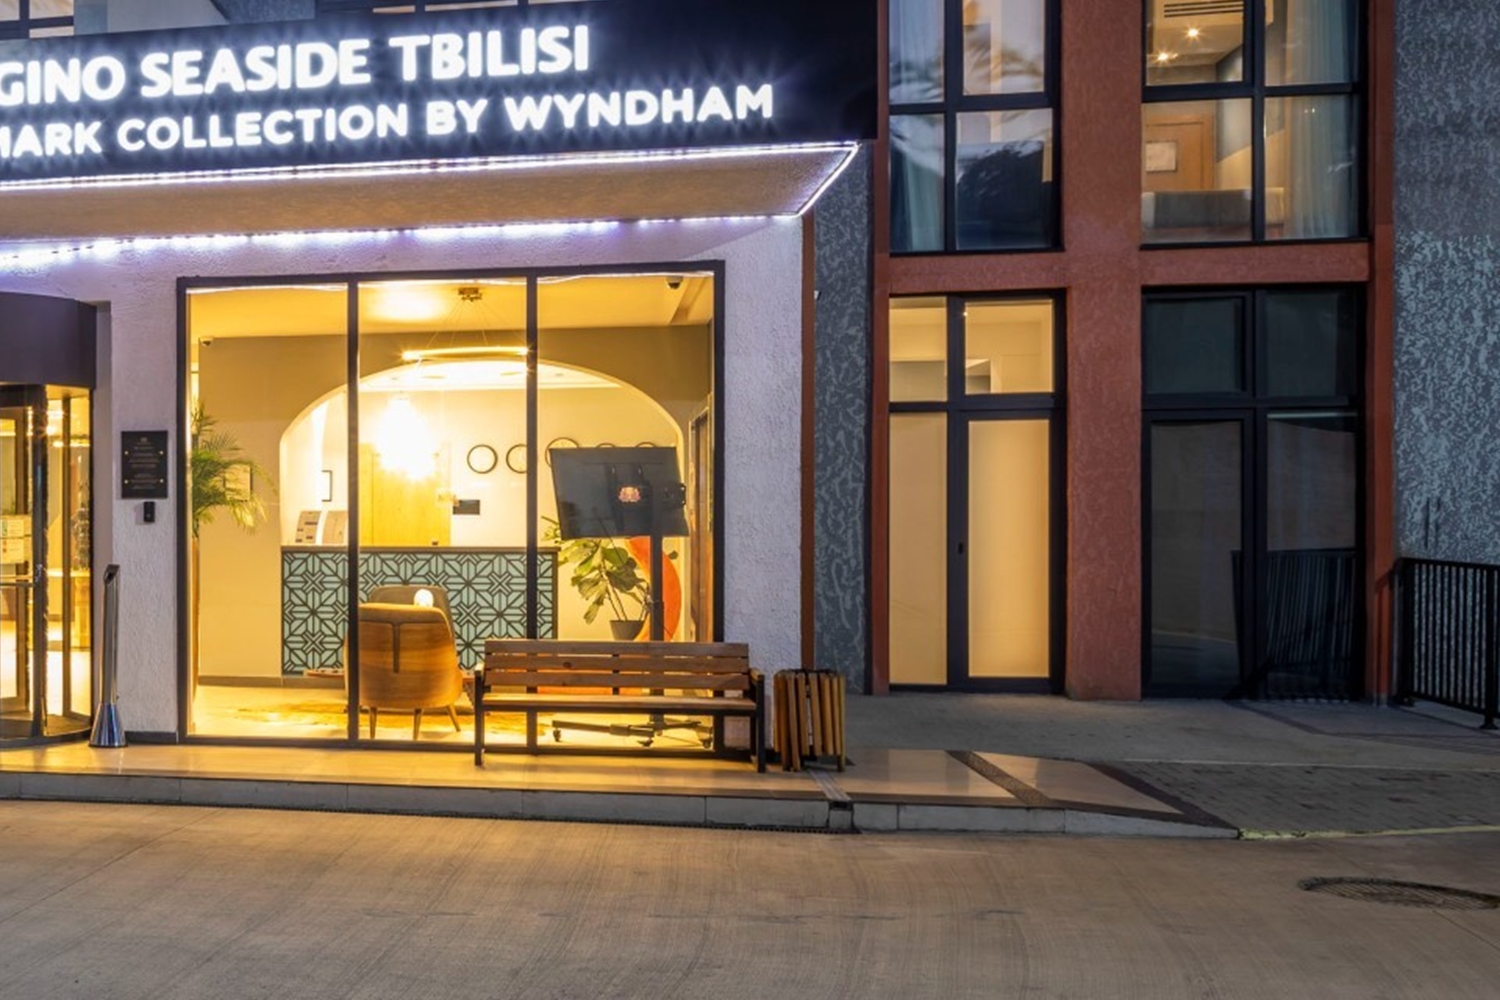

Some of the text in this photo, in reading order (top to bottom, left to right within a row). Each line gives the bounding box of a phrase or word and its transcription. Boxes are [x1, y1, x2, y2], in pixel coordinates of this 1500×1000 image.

[141, 39, 371, 97] SEASIDE
[389, 25, 588, 81] TBILISI
[117, 104, 408, 152] COLLECTION
[426, 99, 487, 135] BY
[504, 84, 773, 132] WYNDHAM
